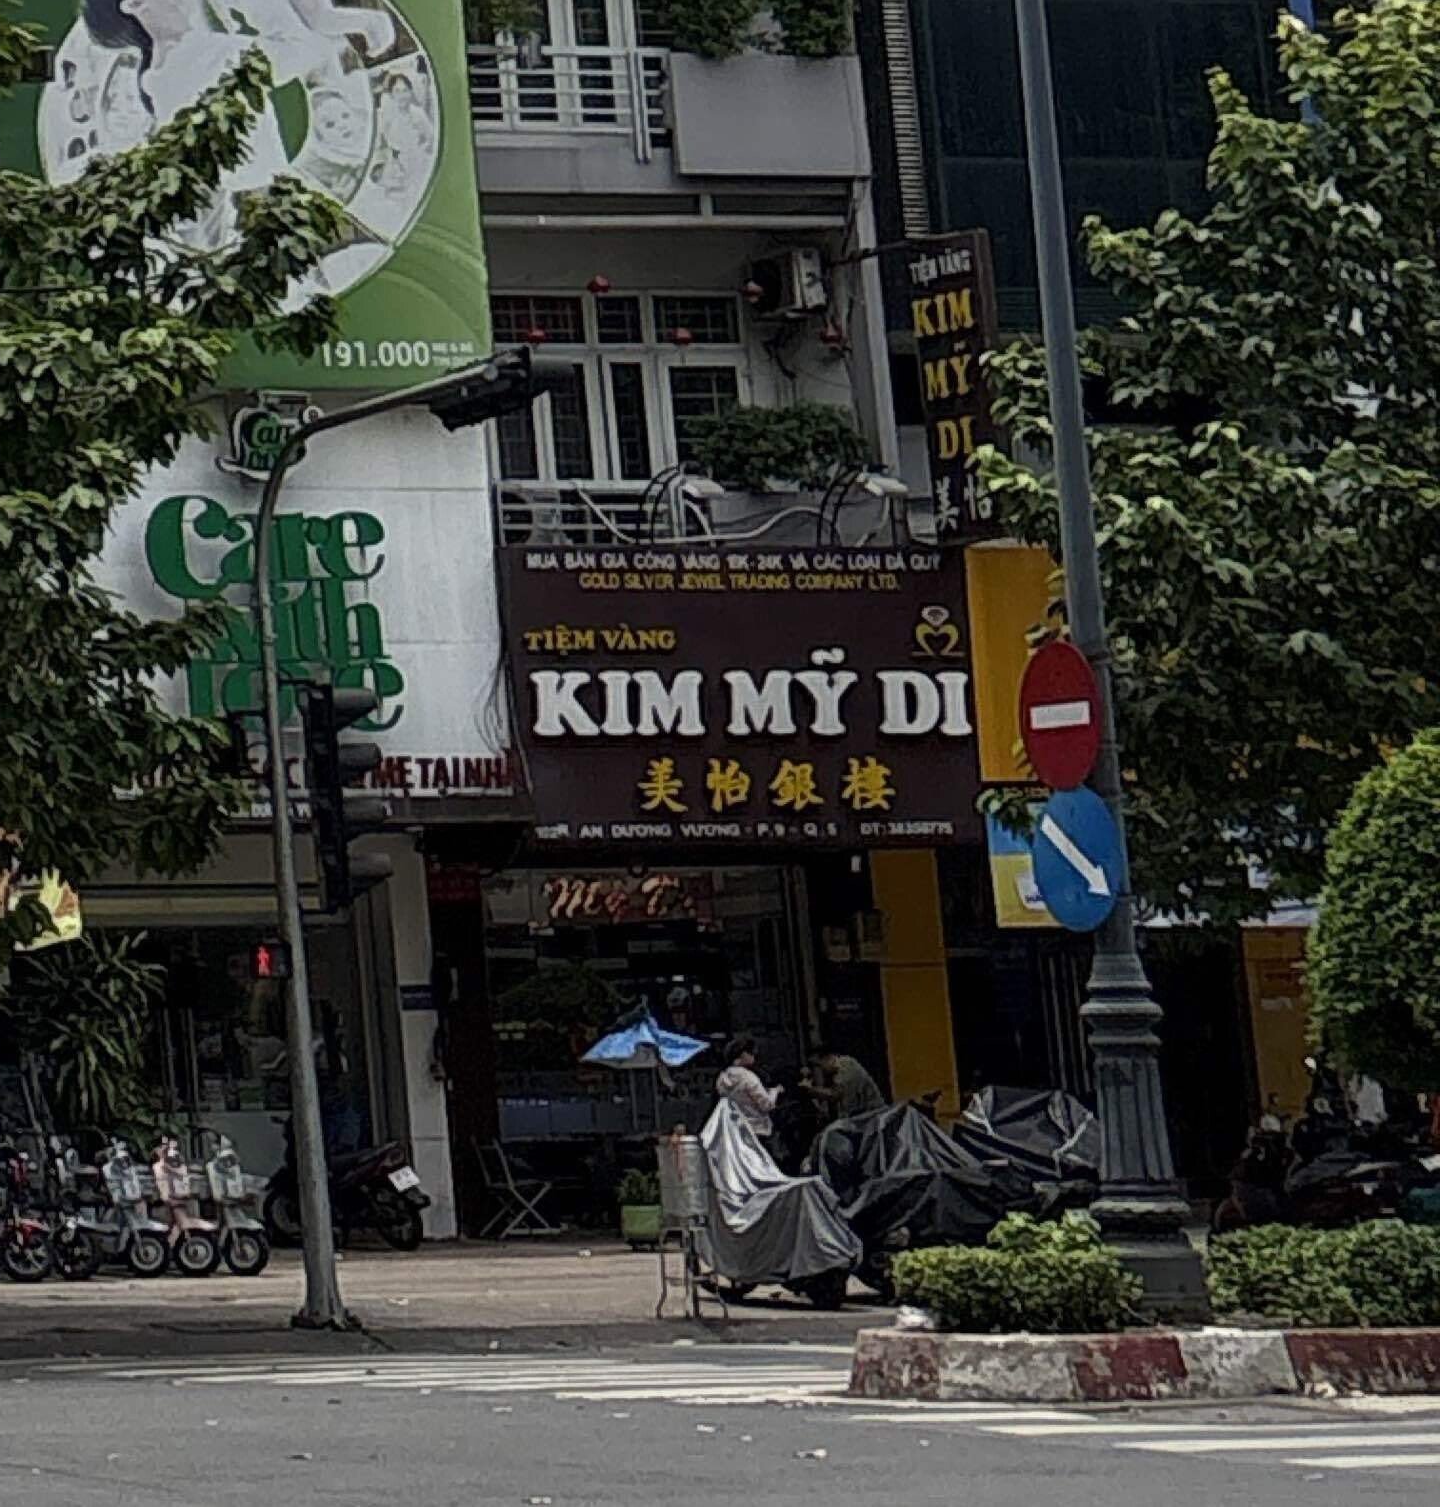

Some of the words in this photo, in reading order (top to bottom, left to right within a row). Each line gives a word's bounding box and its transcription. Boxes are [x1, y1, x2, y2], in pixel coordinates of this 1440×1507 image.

[911, 288, 976, 338] KIM
[321, 340, 430, 367] 191.000
[923, 341, 974, 402] MỸ
[935, 414, 975, 460] DI
[146, 494, 386, 599] Care
[526, 552, 559, 569] MUA
[578, 572, 621, 590] GOLD
[623, 572, 675, 590] SILVER
[728, 573, 791, 591] TRADING
[795, 573, 865, 591] COMPANY
[524, 623, 595, 657] TIỆM
[600, 622, 676, 652] VÀNG
[529, 668, 706, 738] KIM
[723, 647, 858, 737] MỸ
[878, 668, 973, 737] DI
[578, 823, 604, 839] AN
